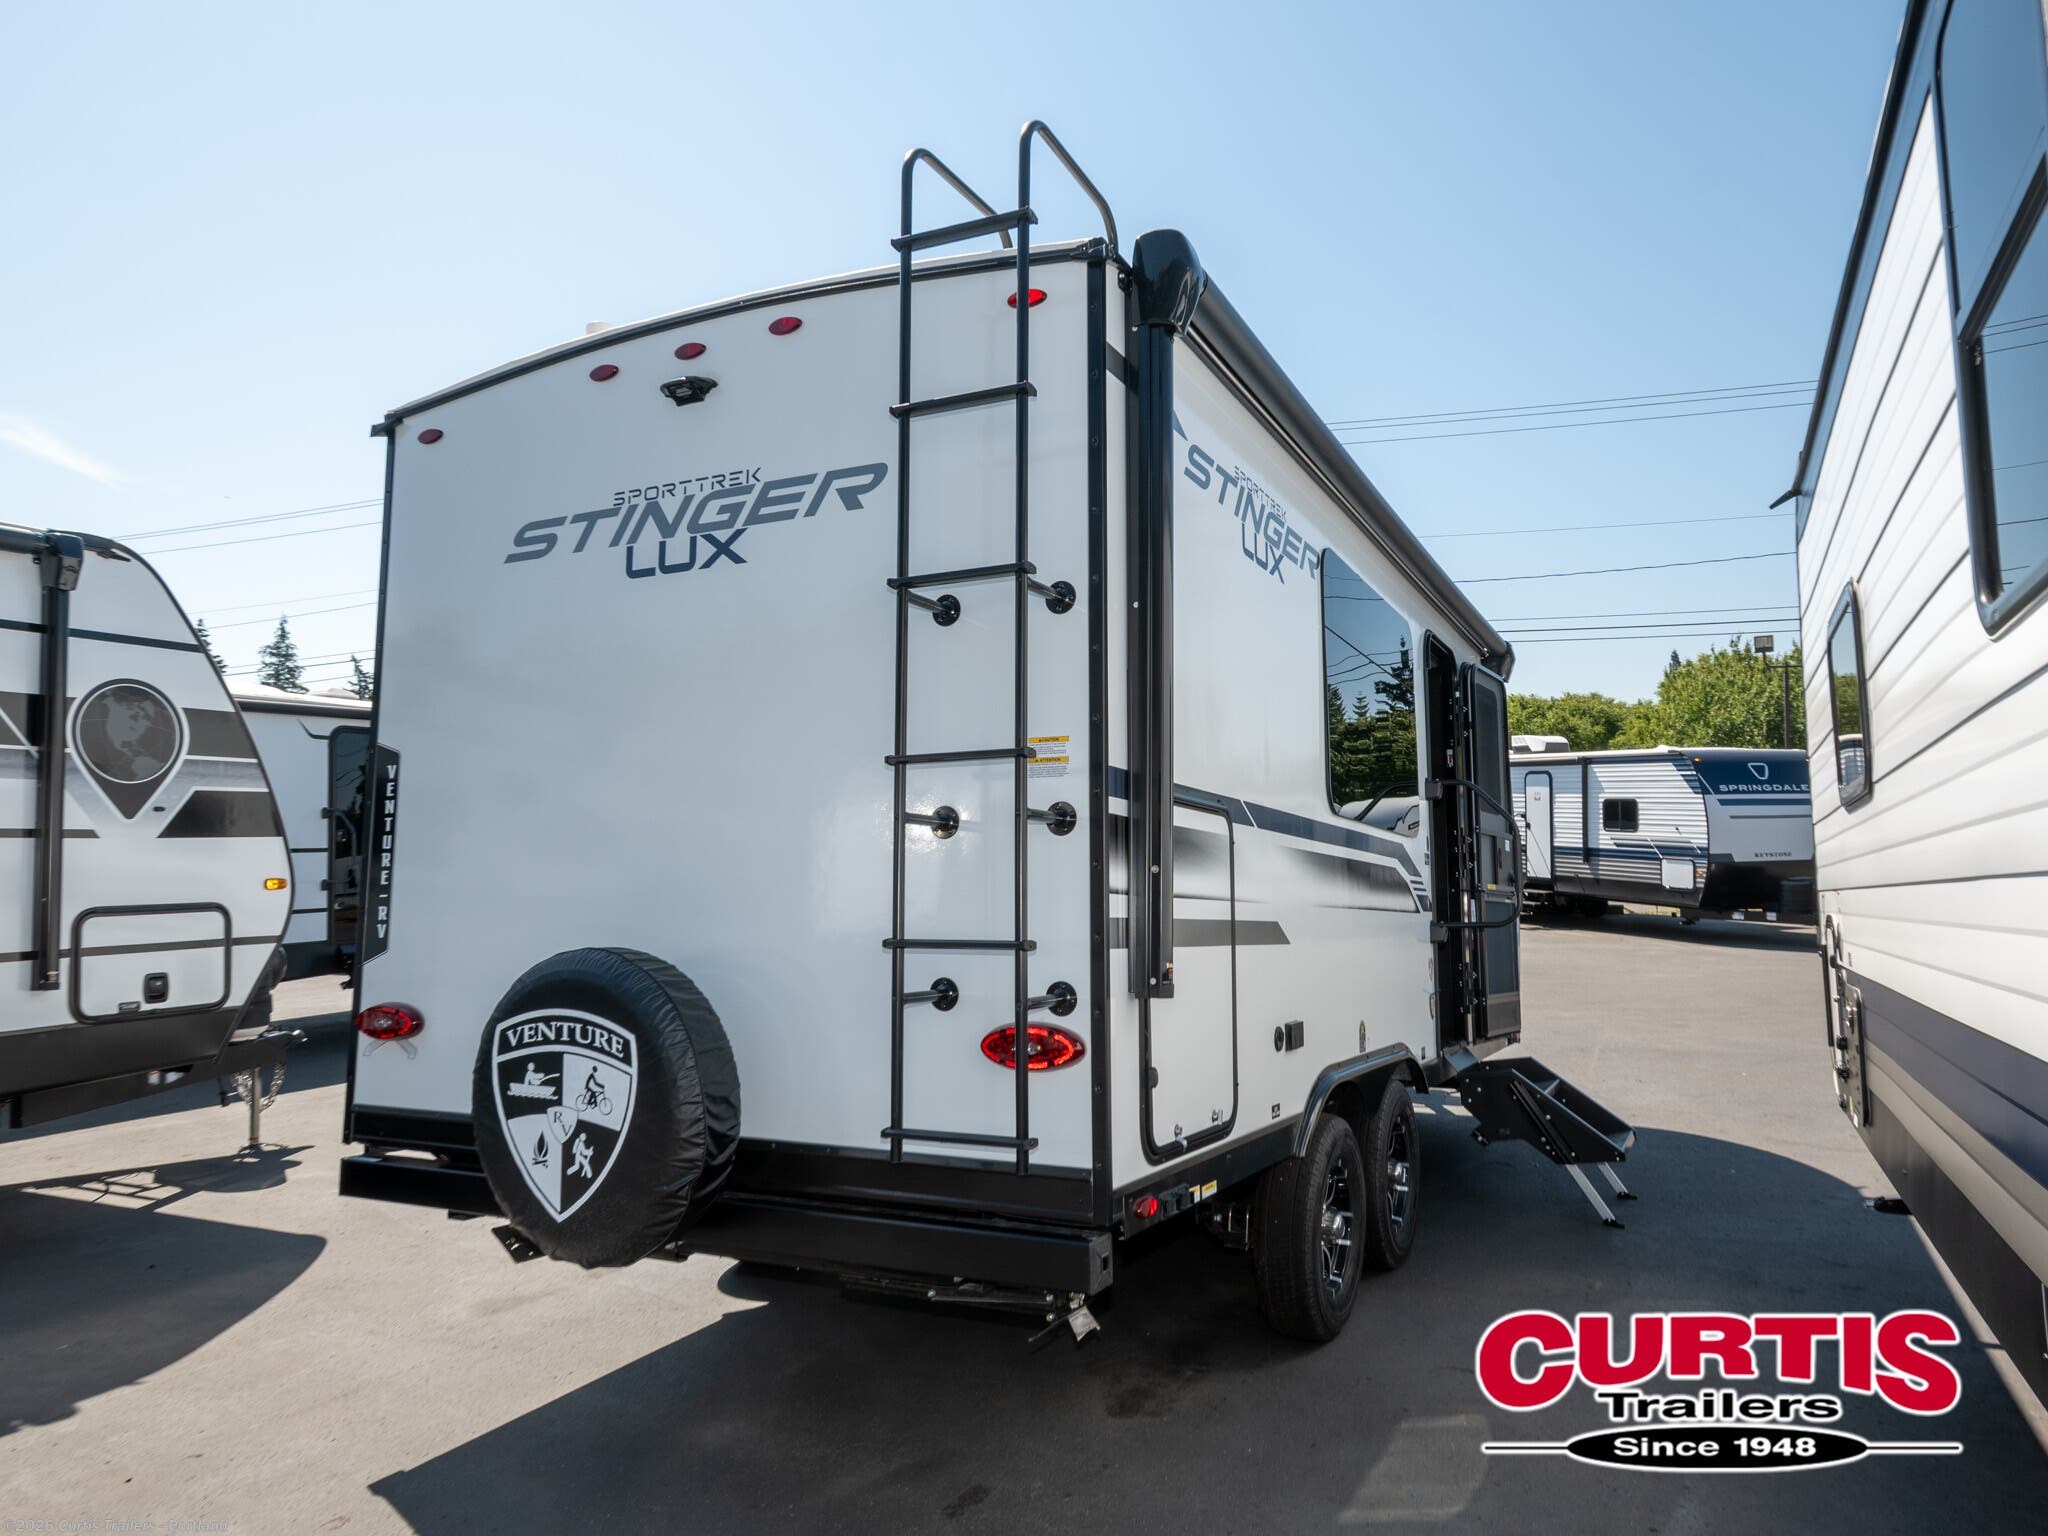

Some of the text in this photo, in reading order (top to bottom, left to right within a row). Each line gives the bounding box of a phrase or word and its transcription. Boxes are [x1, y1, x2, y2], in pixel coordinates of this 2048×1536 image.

[504, 462, 888, 564] STINGER
[613, 467, 761, 507] SPORTTREK
[1184, 444, 1320, 580] STINGER
[1234, 465, 1287, 521] SPORTTREK
[625, 527, 748, 579] LUX
[1242, 523, 1285, 584] LUX
[1719, 784, 1810, 792] SPRINGDALE
[506, 1021, 624, 1058] VENTURE
